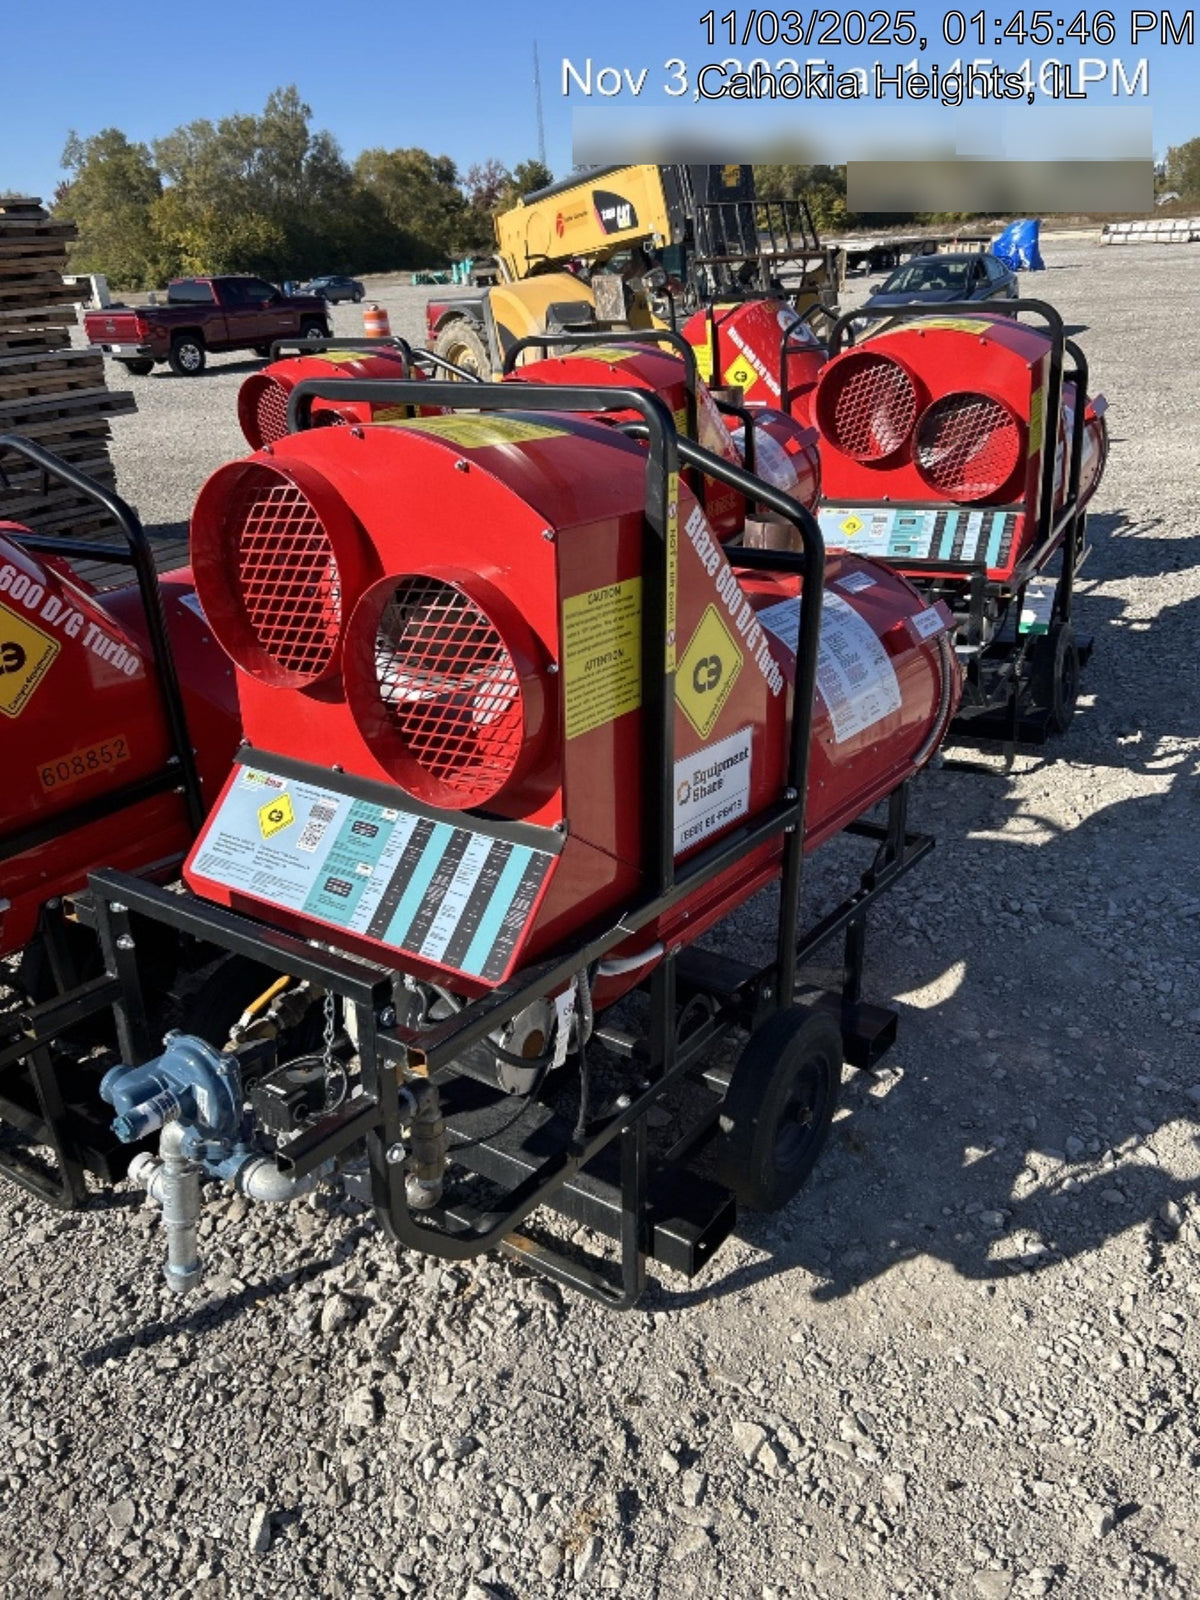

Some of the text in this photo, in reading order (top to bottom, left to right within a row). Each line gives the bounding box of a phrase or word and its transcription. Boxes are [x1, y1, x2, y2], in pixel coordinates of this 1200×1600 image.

[587, 585, 622, 605] CAUTION
[685, 505, 720, 576] Blaze
[716, 564, 742, 616] 600
[736, 601, 760, 651] D/G
[755, 636, 783, 696] Turbo
[0, 564, 139, 676] 600 D/G Turbo
[584, 648, 625, 673] ATTENTION
[42, 739, 128, 787] 608852
[693, 747, 749, 786] Equipment
[692, 778, 724, 802] Share
